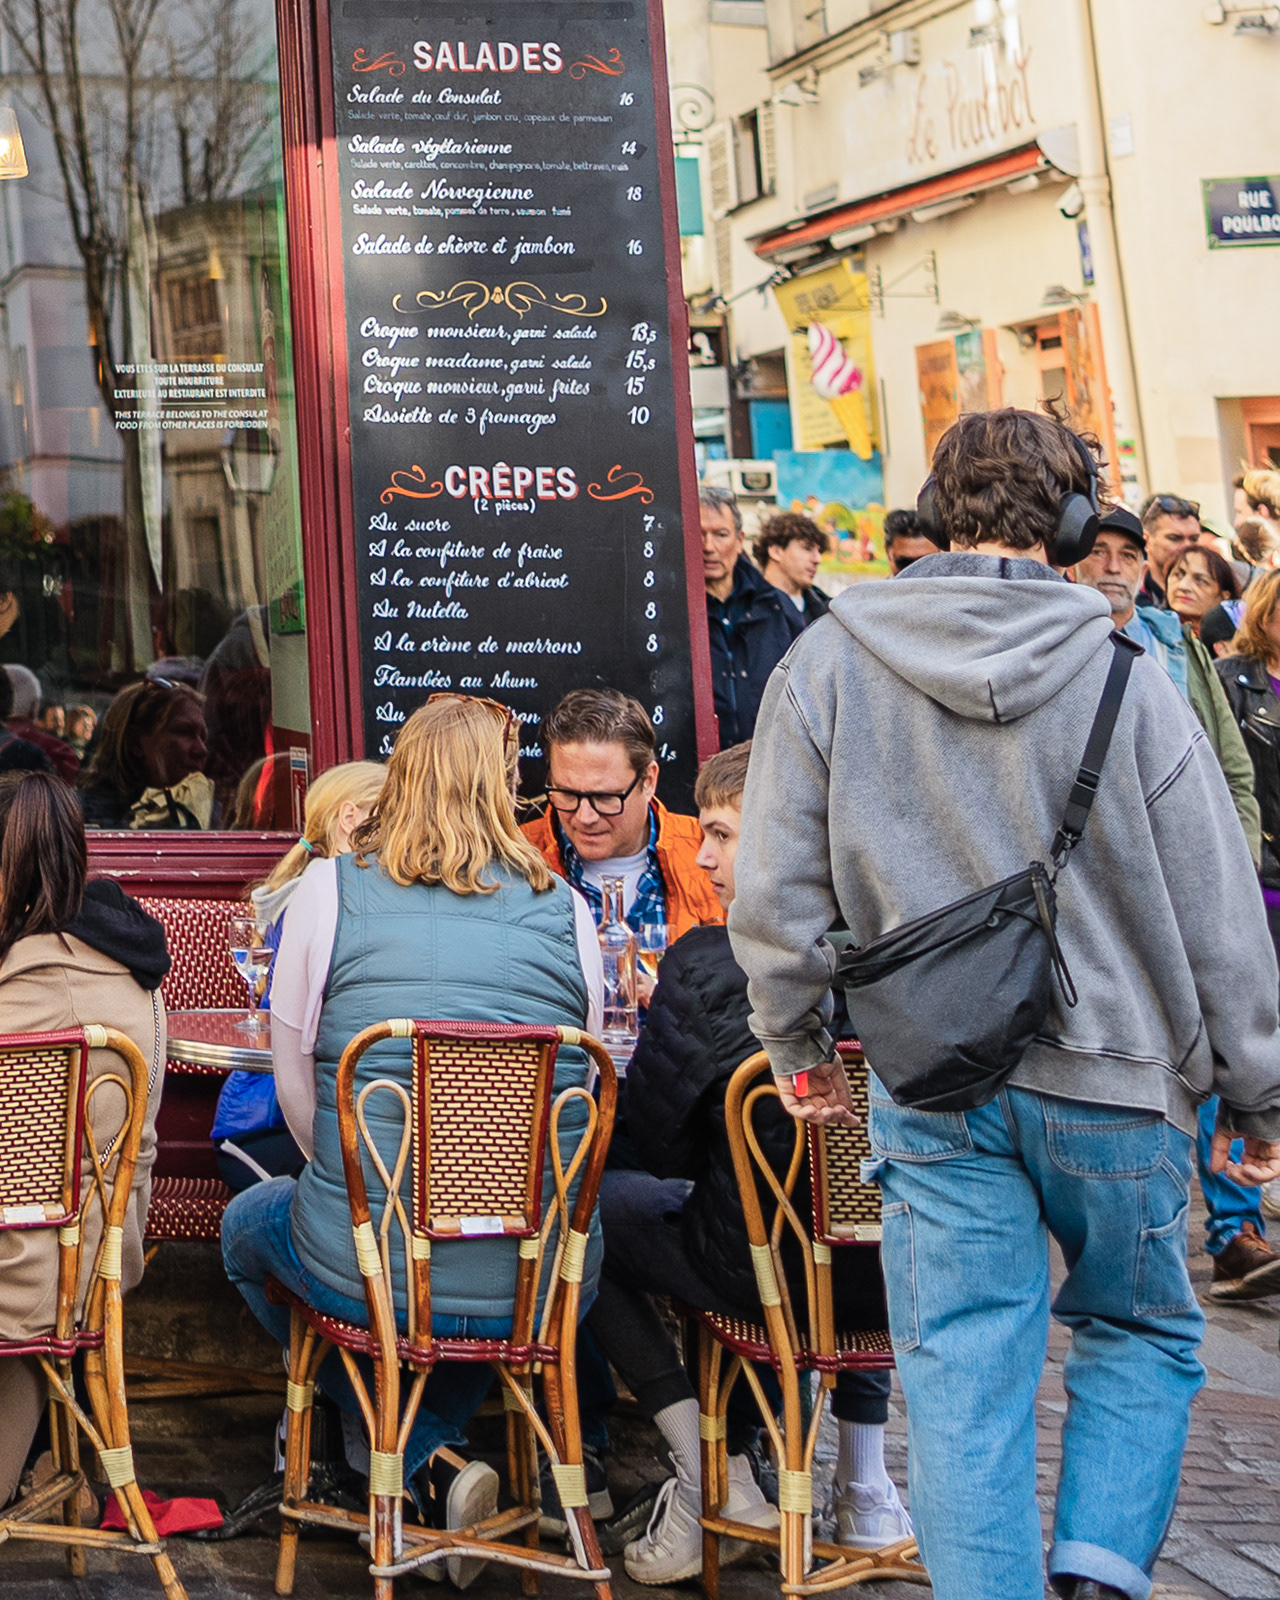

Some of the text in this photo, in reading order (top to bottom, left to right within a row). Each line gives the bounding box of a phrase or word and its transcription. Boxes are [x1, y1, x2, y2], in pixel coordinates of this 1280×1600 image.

[412, 40, 562, 74] SALADES
[347, 84, 634, 106] Salade du Consulat 16
[348, 134, 637, 161] Salade végétarienne 14
[350, 179, 414, 200] Salade
[626, 186, 641, 201] 18
[1238, 190, 1272, 208] RUE
[115, 364, 135, 373] VOUS
[155, 364, 168, 373] SUR
[170, 364, 178, 373] LA
[180, 364, 214, 373] TERRASSE
[216, 364, 226, 373] DU
[228, 364, 264, 373] CONSULAT
[362, 347, 419, 377] Croque
[510, 352, 545, 374] garni
[551, 352, 591, 369] salade
[155, 377, 224, 385] TOUTE NOURRITURE
[445, 461, 578, 499] CRÊPES
[474, 498, 535, 515] (2 pièces)
[368, 512, 398, 531] Au
[404, 518, 450, 531] sucre
[372, 599, 656, 619] Au Nutella 8
[396, 633, 418, 651] la
[421, 635, 471, 652] crème
[479, 635, 498, 652] de
[506, 639, 581, 654] marrons
[647, 634, 658, 652] 8
